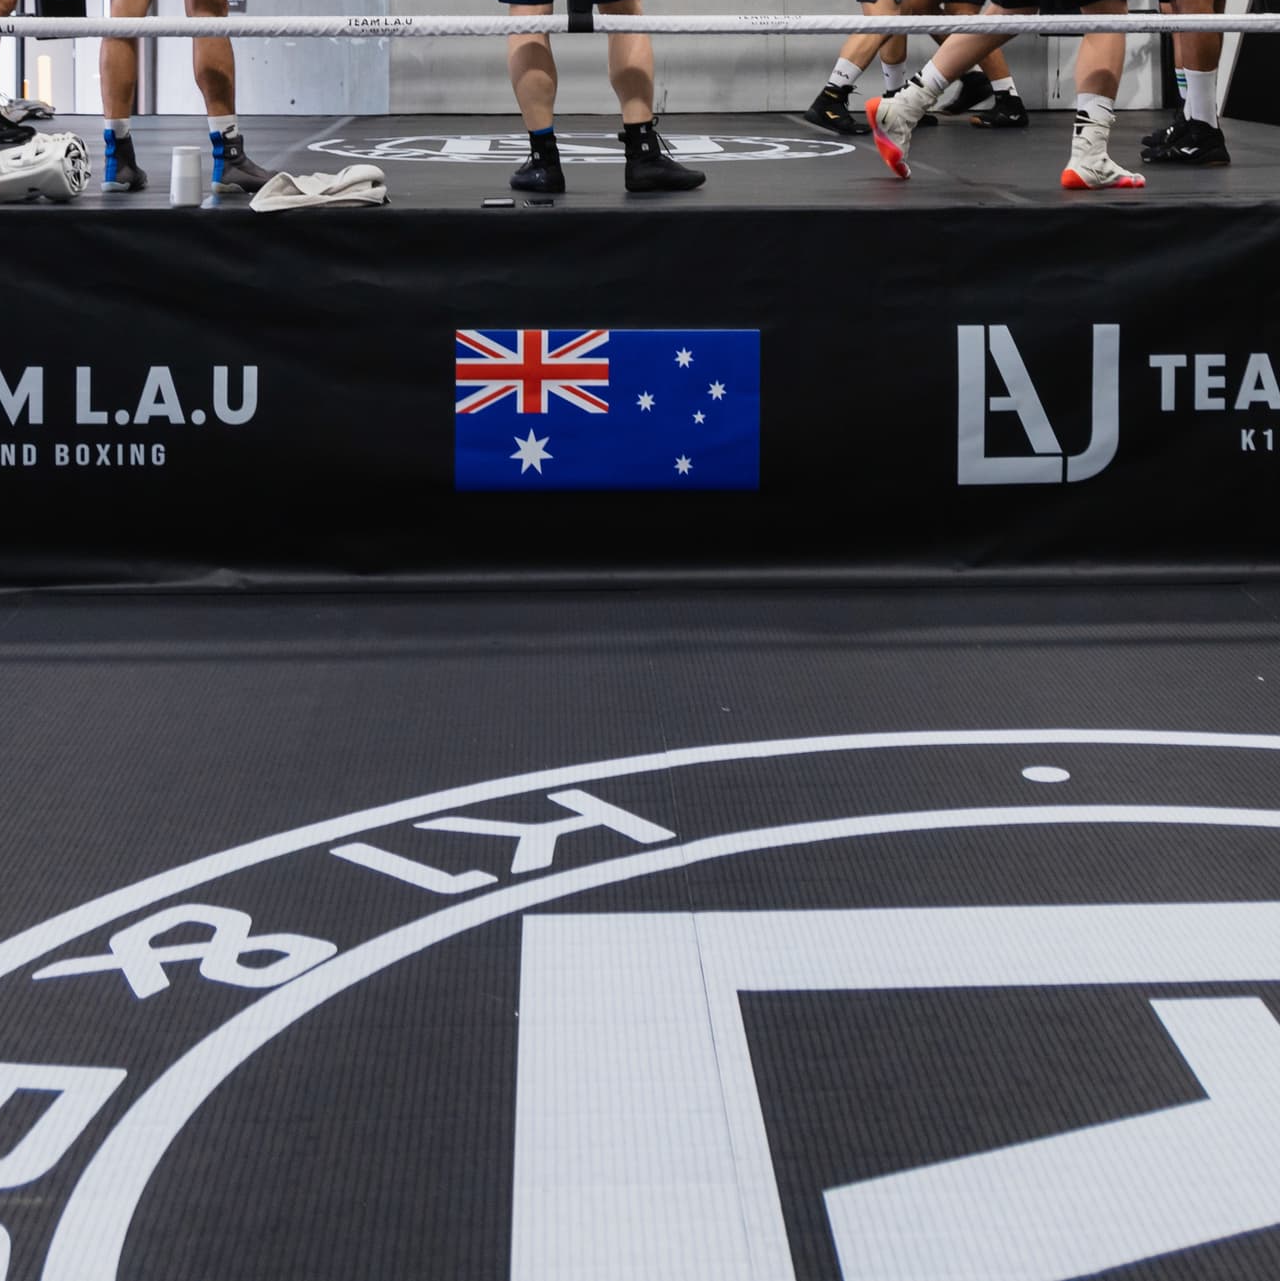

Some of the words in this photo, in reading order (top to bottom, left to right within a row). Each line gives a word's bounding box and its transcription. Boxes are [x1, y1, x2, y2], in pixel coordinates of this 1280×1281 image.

[348, 18, 380, 26] TEAM
[384, 18, 413, 26] L.A.U
[76, 365, 258, 425] L.A.U
[1241, 429, 1275, 451] K1
[55, 443, 166, 466] BOXING
